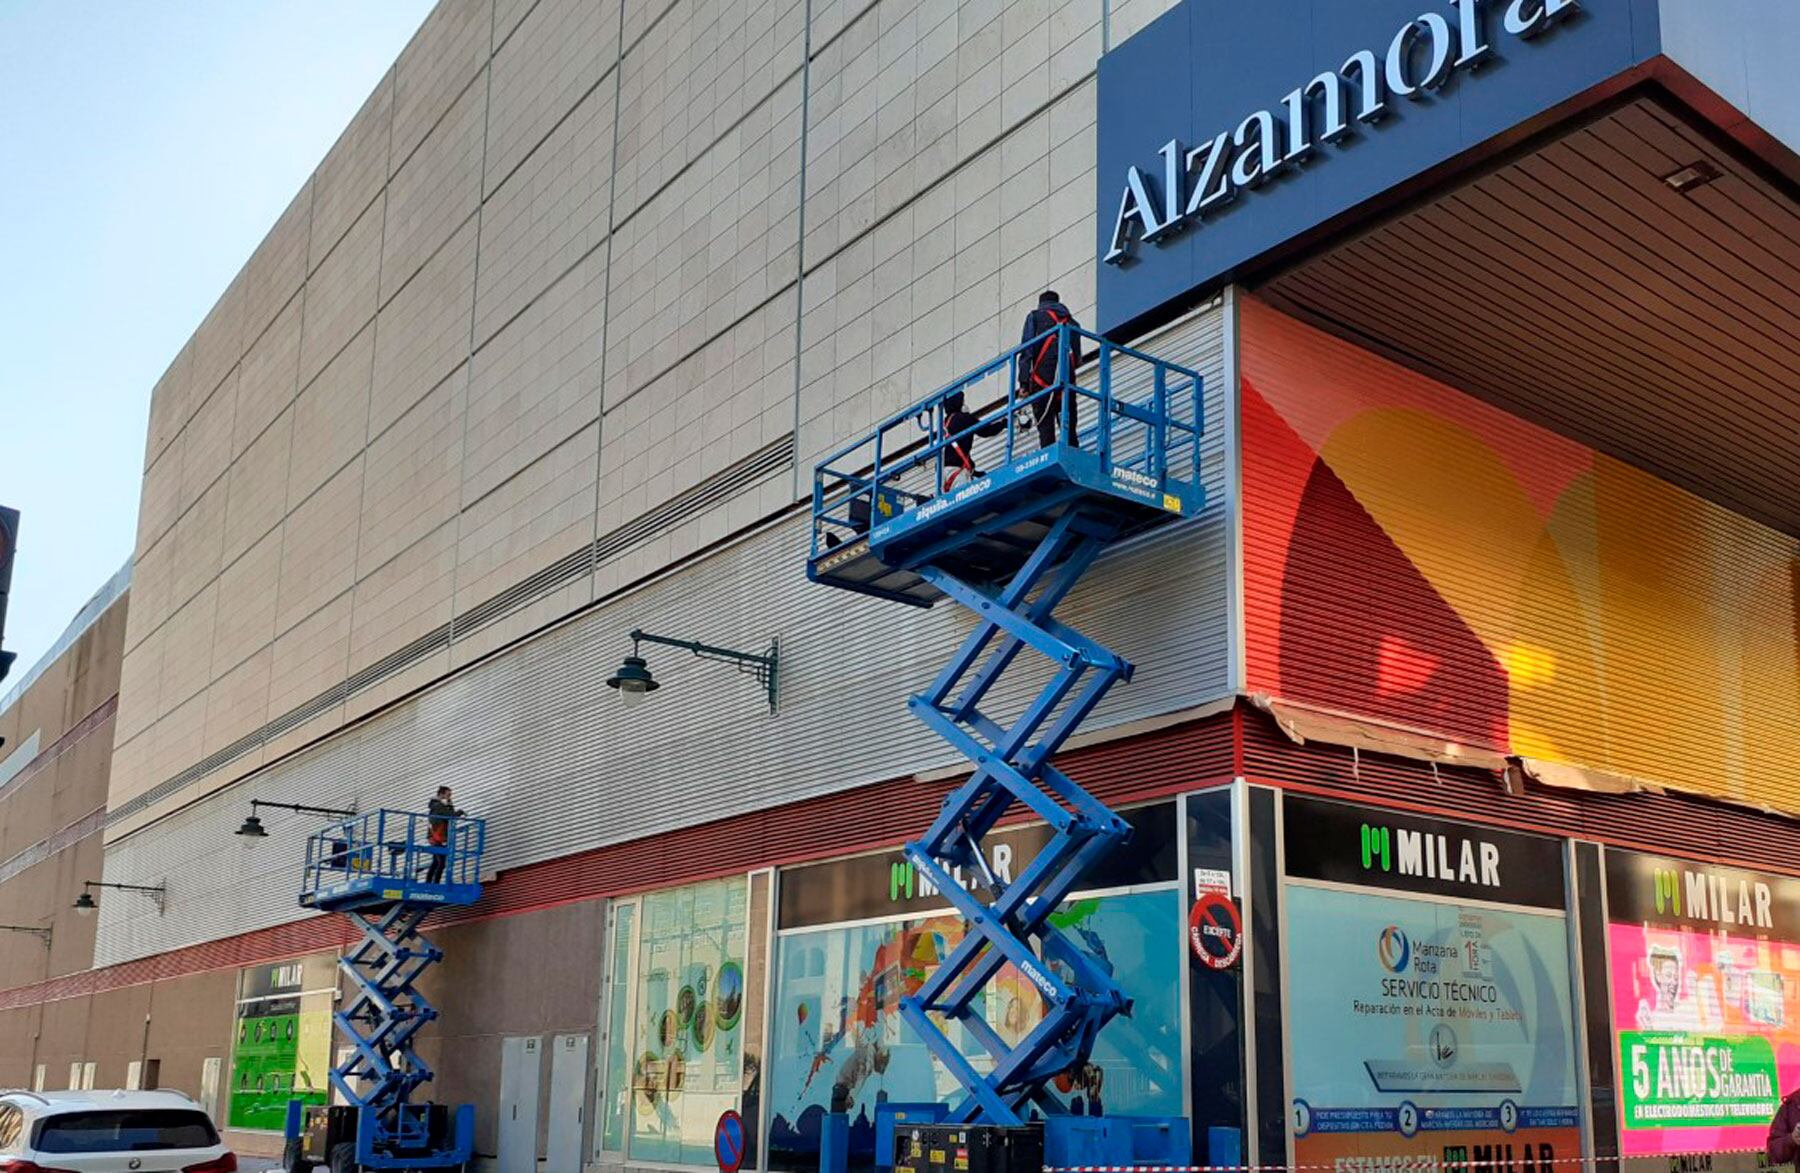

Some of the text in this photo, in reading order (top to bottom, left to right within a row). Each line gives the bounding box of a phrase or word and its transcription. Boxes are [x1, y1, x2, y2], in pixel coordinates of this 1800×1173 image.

[1113, 467, 1157, 488] mateco
[955, 478, 991, 503] mateco
[1397, 829, 1500, 886] MILAR
[1685, 871, 1773, 928] MILAR
[1412, 940, 1458, 958] Manzana
[1414, 957, 1437, 974] Rota
[1020, 960, 1057, 997] mateco
[1382, 978, 1497, 1003] SERVICIO TÉCNICO
[1403, 1006, 1414, 1015] en
[1416, 1005, 1424, 1015] el
[1446, 1007, 1456, 1018] de
[1719, 1048, 1734, 1071] DE
[1631, 1044, 1650, 1099] 5
[1296, 1110, 1302, 1127] 1
[1404, 1110, 1411, 1126] 2
[1505, 1105, 1512, 1122] 3
